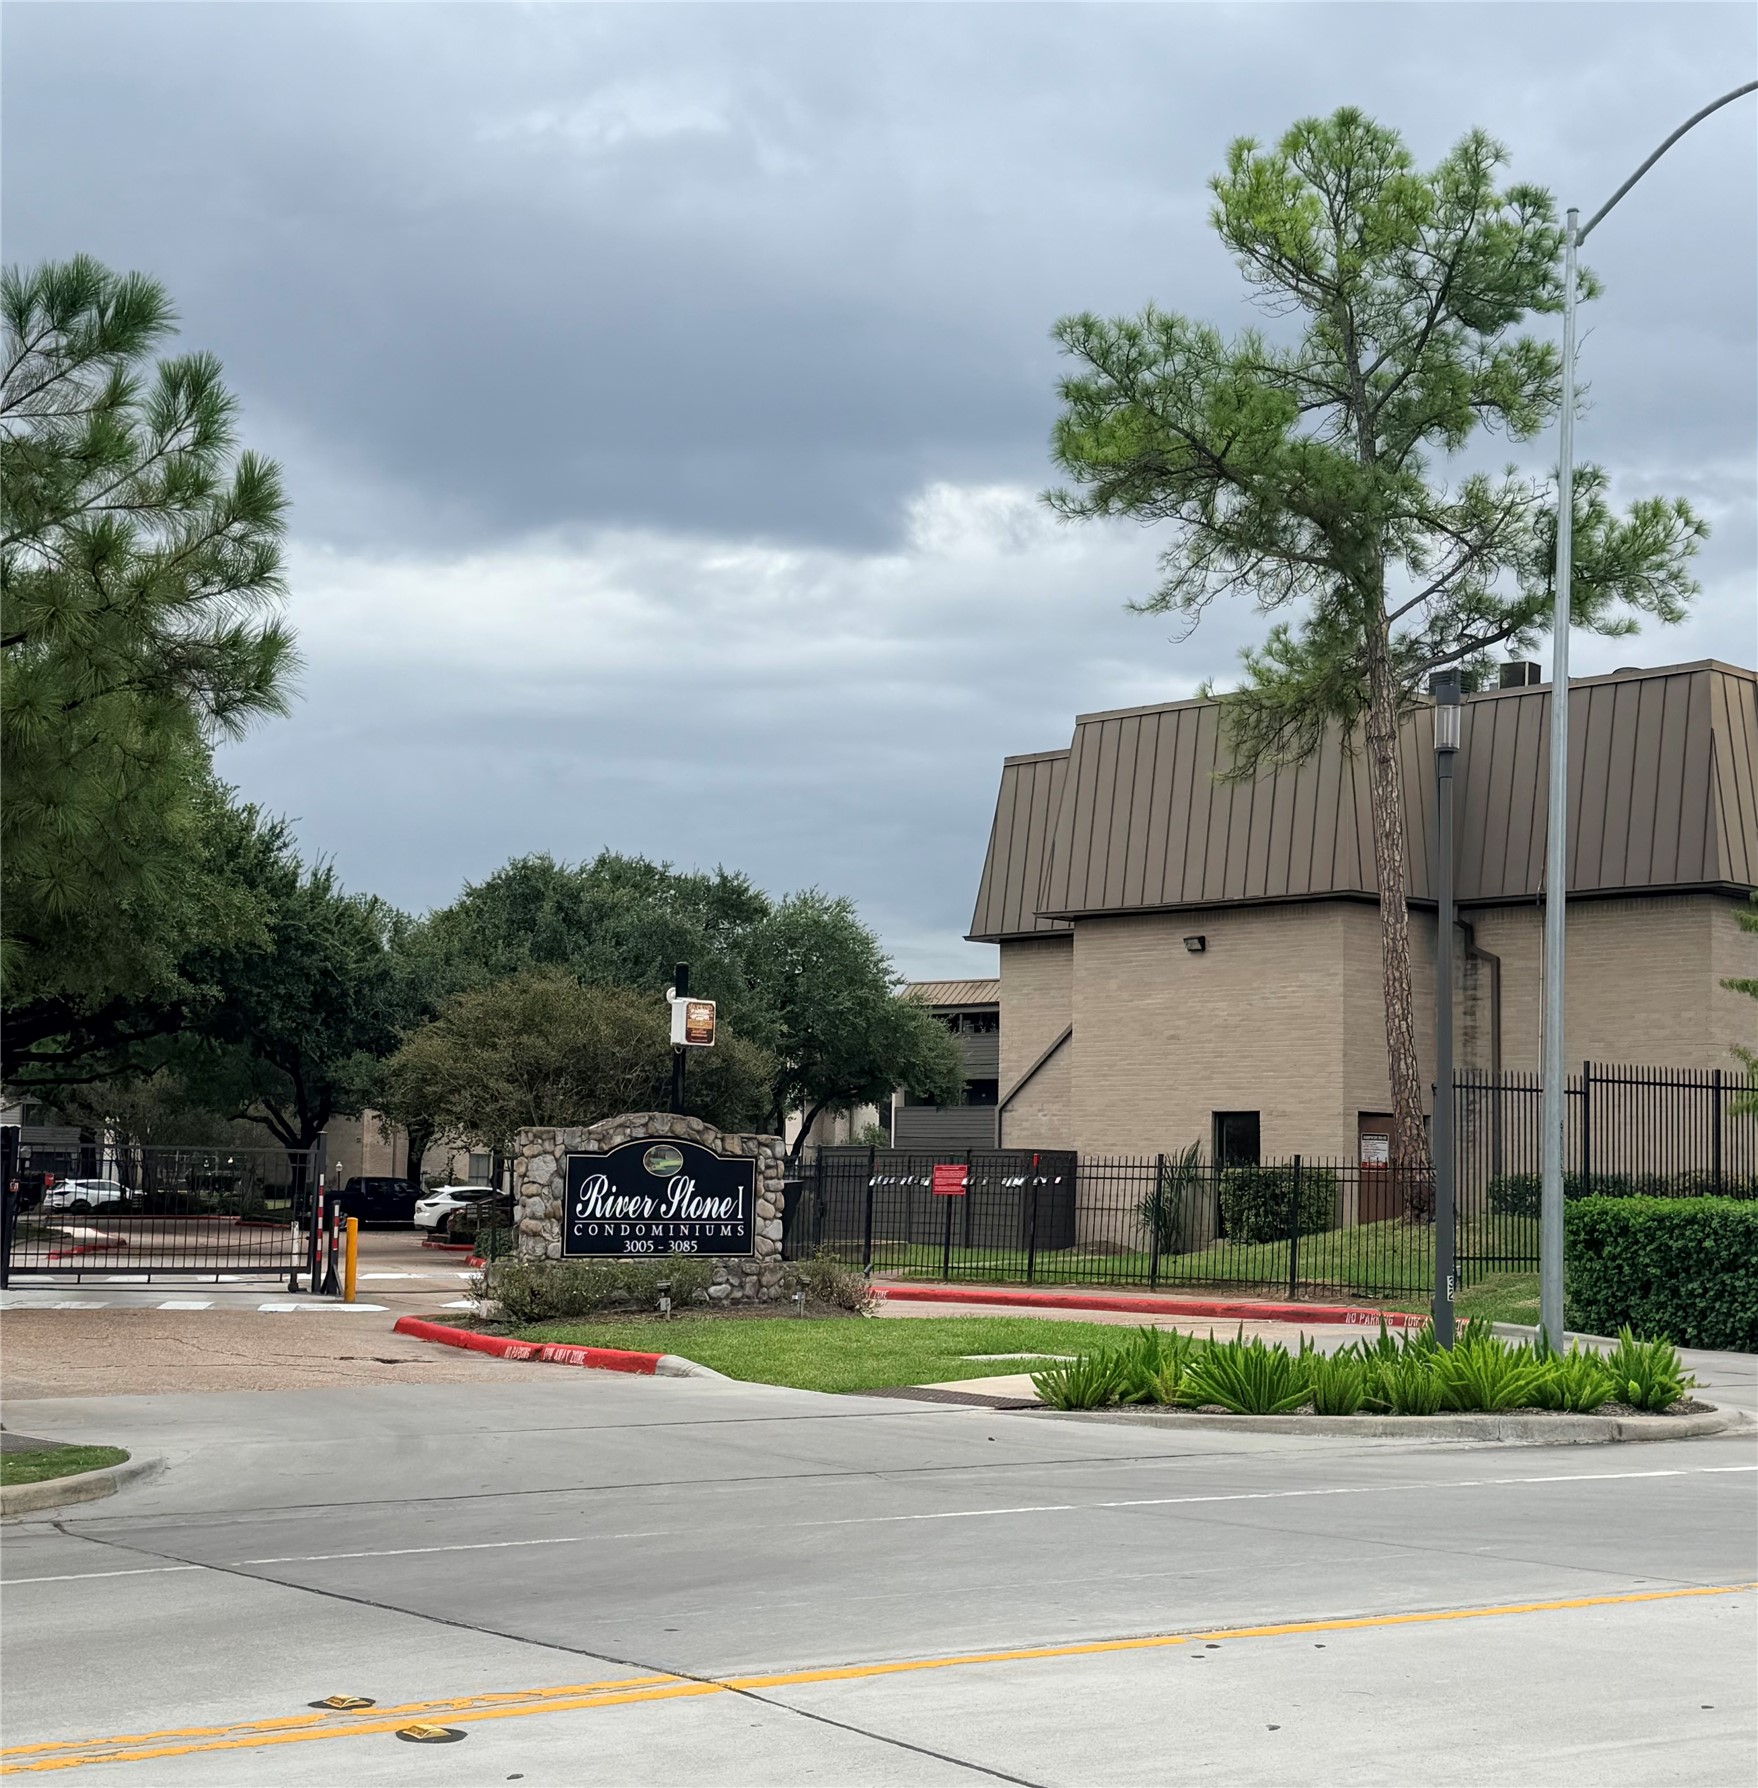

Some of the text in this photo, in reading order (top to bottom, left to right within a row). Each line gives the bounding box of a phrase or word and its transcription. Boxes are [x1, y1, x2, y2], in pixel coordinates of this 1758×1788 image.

[576, 1174, 744, 1219] River Stone I
[574, 1225, 744, 1236] CONDOMINIUMS
[623, 1240, 654, 1252] 3005
[668, 1240, 697, 1252] 3085
[1346, 1312, 1357, 1324] NO
[1359, 1312, 1394, 1326] PARKNG
